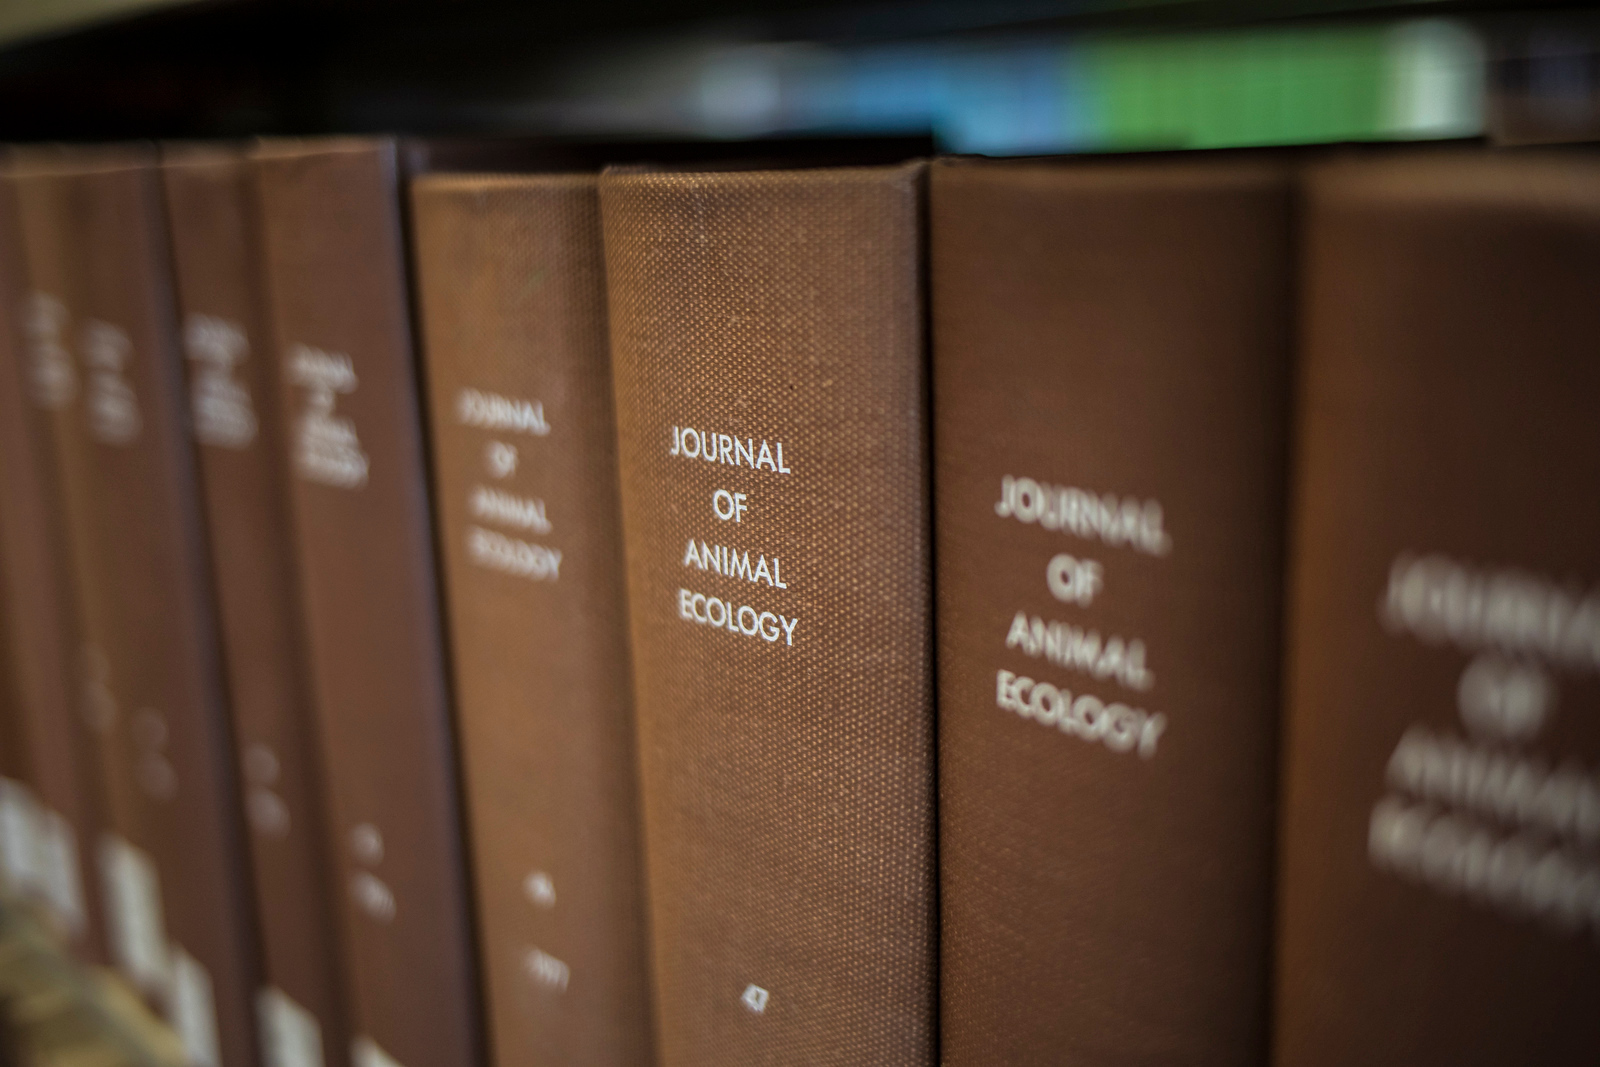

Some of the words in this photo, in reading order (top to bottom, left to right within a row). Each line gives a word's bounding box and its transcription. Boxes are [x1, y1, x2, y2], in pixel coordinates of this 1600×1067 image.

[670, 425, 791, 474] JOURNAL
[713, 489, 748, 522] OF
[994, 474, 1172, 557] JOURNAL
[684, 539, 787, 589] ANIMAL
[1046, 553, 1104, 608] OF
[679, 588, 798, 646] ECOLOGY
[1005, 610, 1155, 692] ANIMAL
[996, 668, 1168, 759] ECOLOGY
